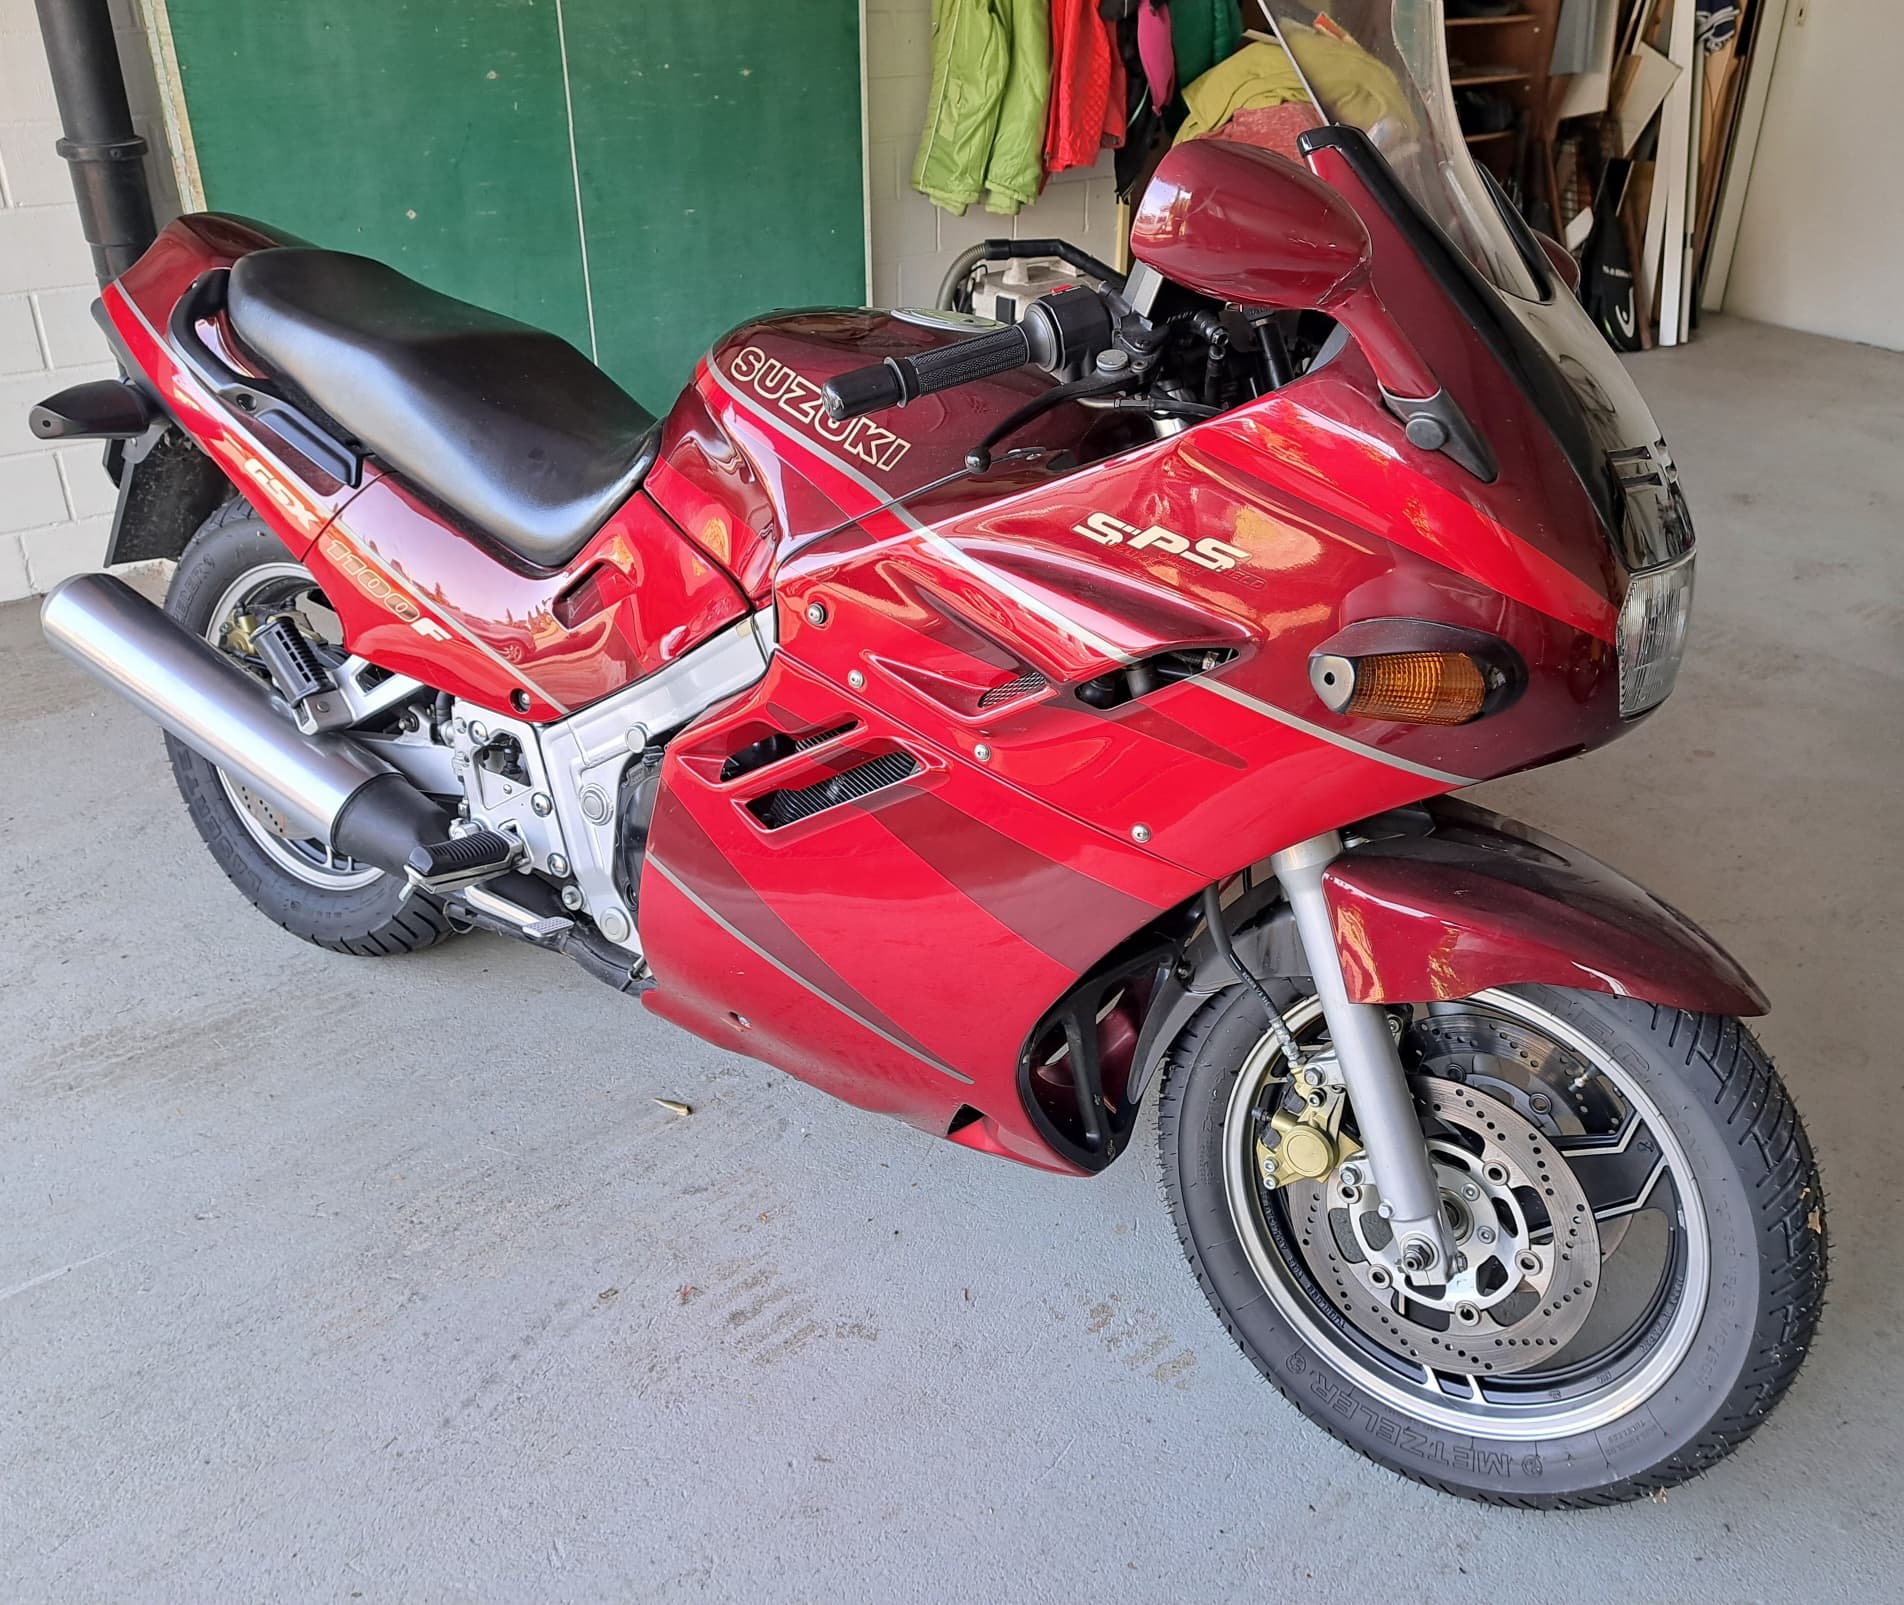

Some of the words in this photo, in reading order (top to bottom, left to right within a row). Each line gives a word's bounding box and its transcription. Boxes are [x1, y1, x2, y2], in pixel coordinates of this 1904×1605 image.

[731, 346, 911, 472] SUZUKI
[244, 457, 320, 530] GSX
[1310, 1373, 1513, 1479] METZELER
